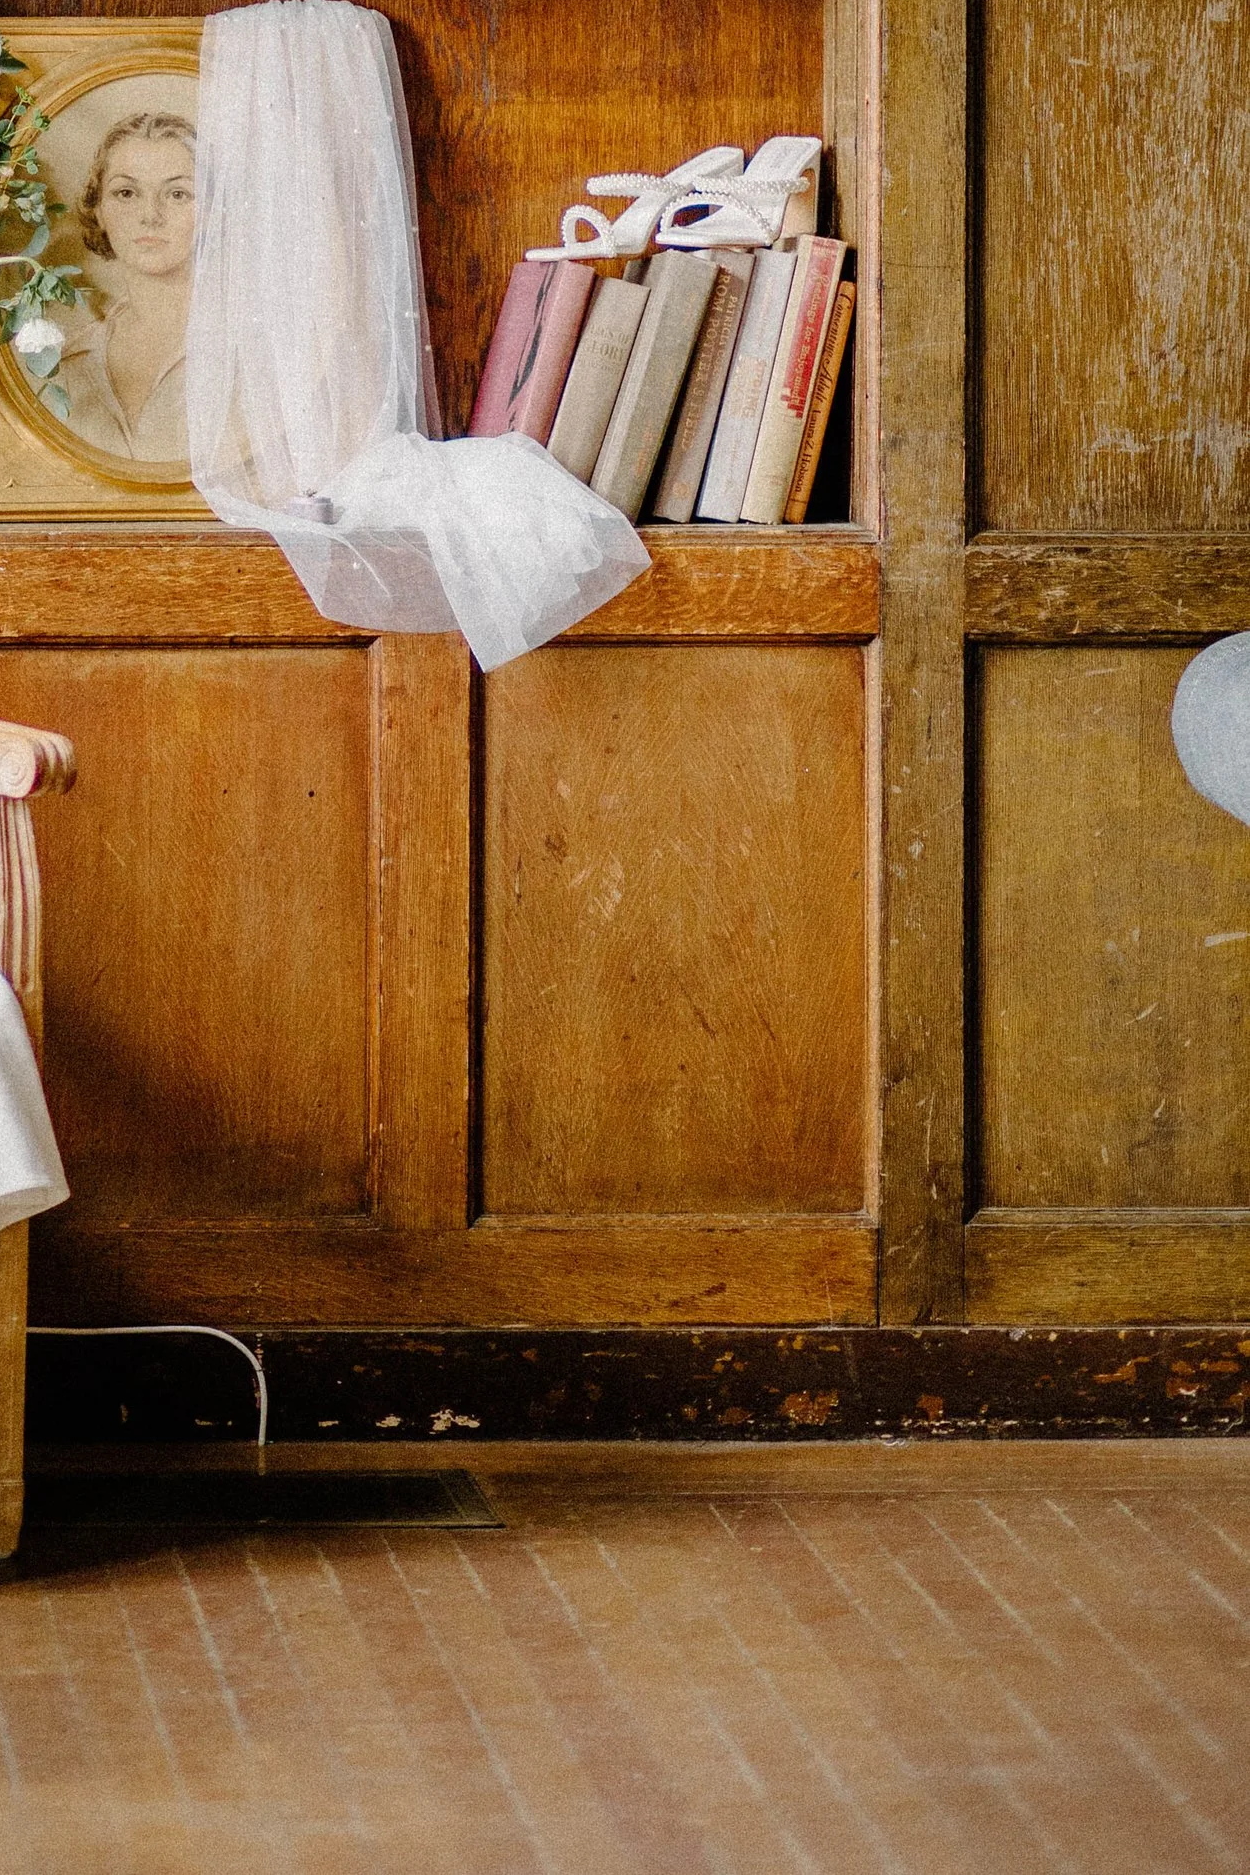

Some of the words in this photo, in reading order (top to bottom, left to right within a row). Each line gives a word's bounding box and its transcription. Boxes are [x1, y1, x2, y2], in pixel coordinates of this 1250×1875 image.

[717, 295, 737, 345] PATRICIA
[803, 272, 828, 324] Readings
[802, 326, 815, 343] for
[822, 292, 854, 359] Consenting
[786, 344, 810, 405] Enjoyment
[813, 358, 837, 404] Adult
[679, 402, 702, 451] FIELD
[805, 409, 823, 439] Laura
[793, 453, 812, 493] Hobson
